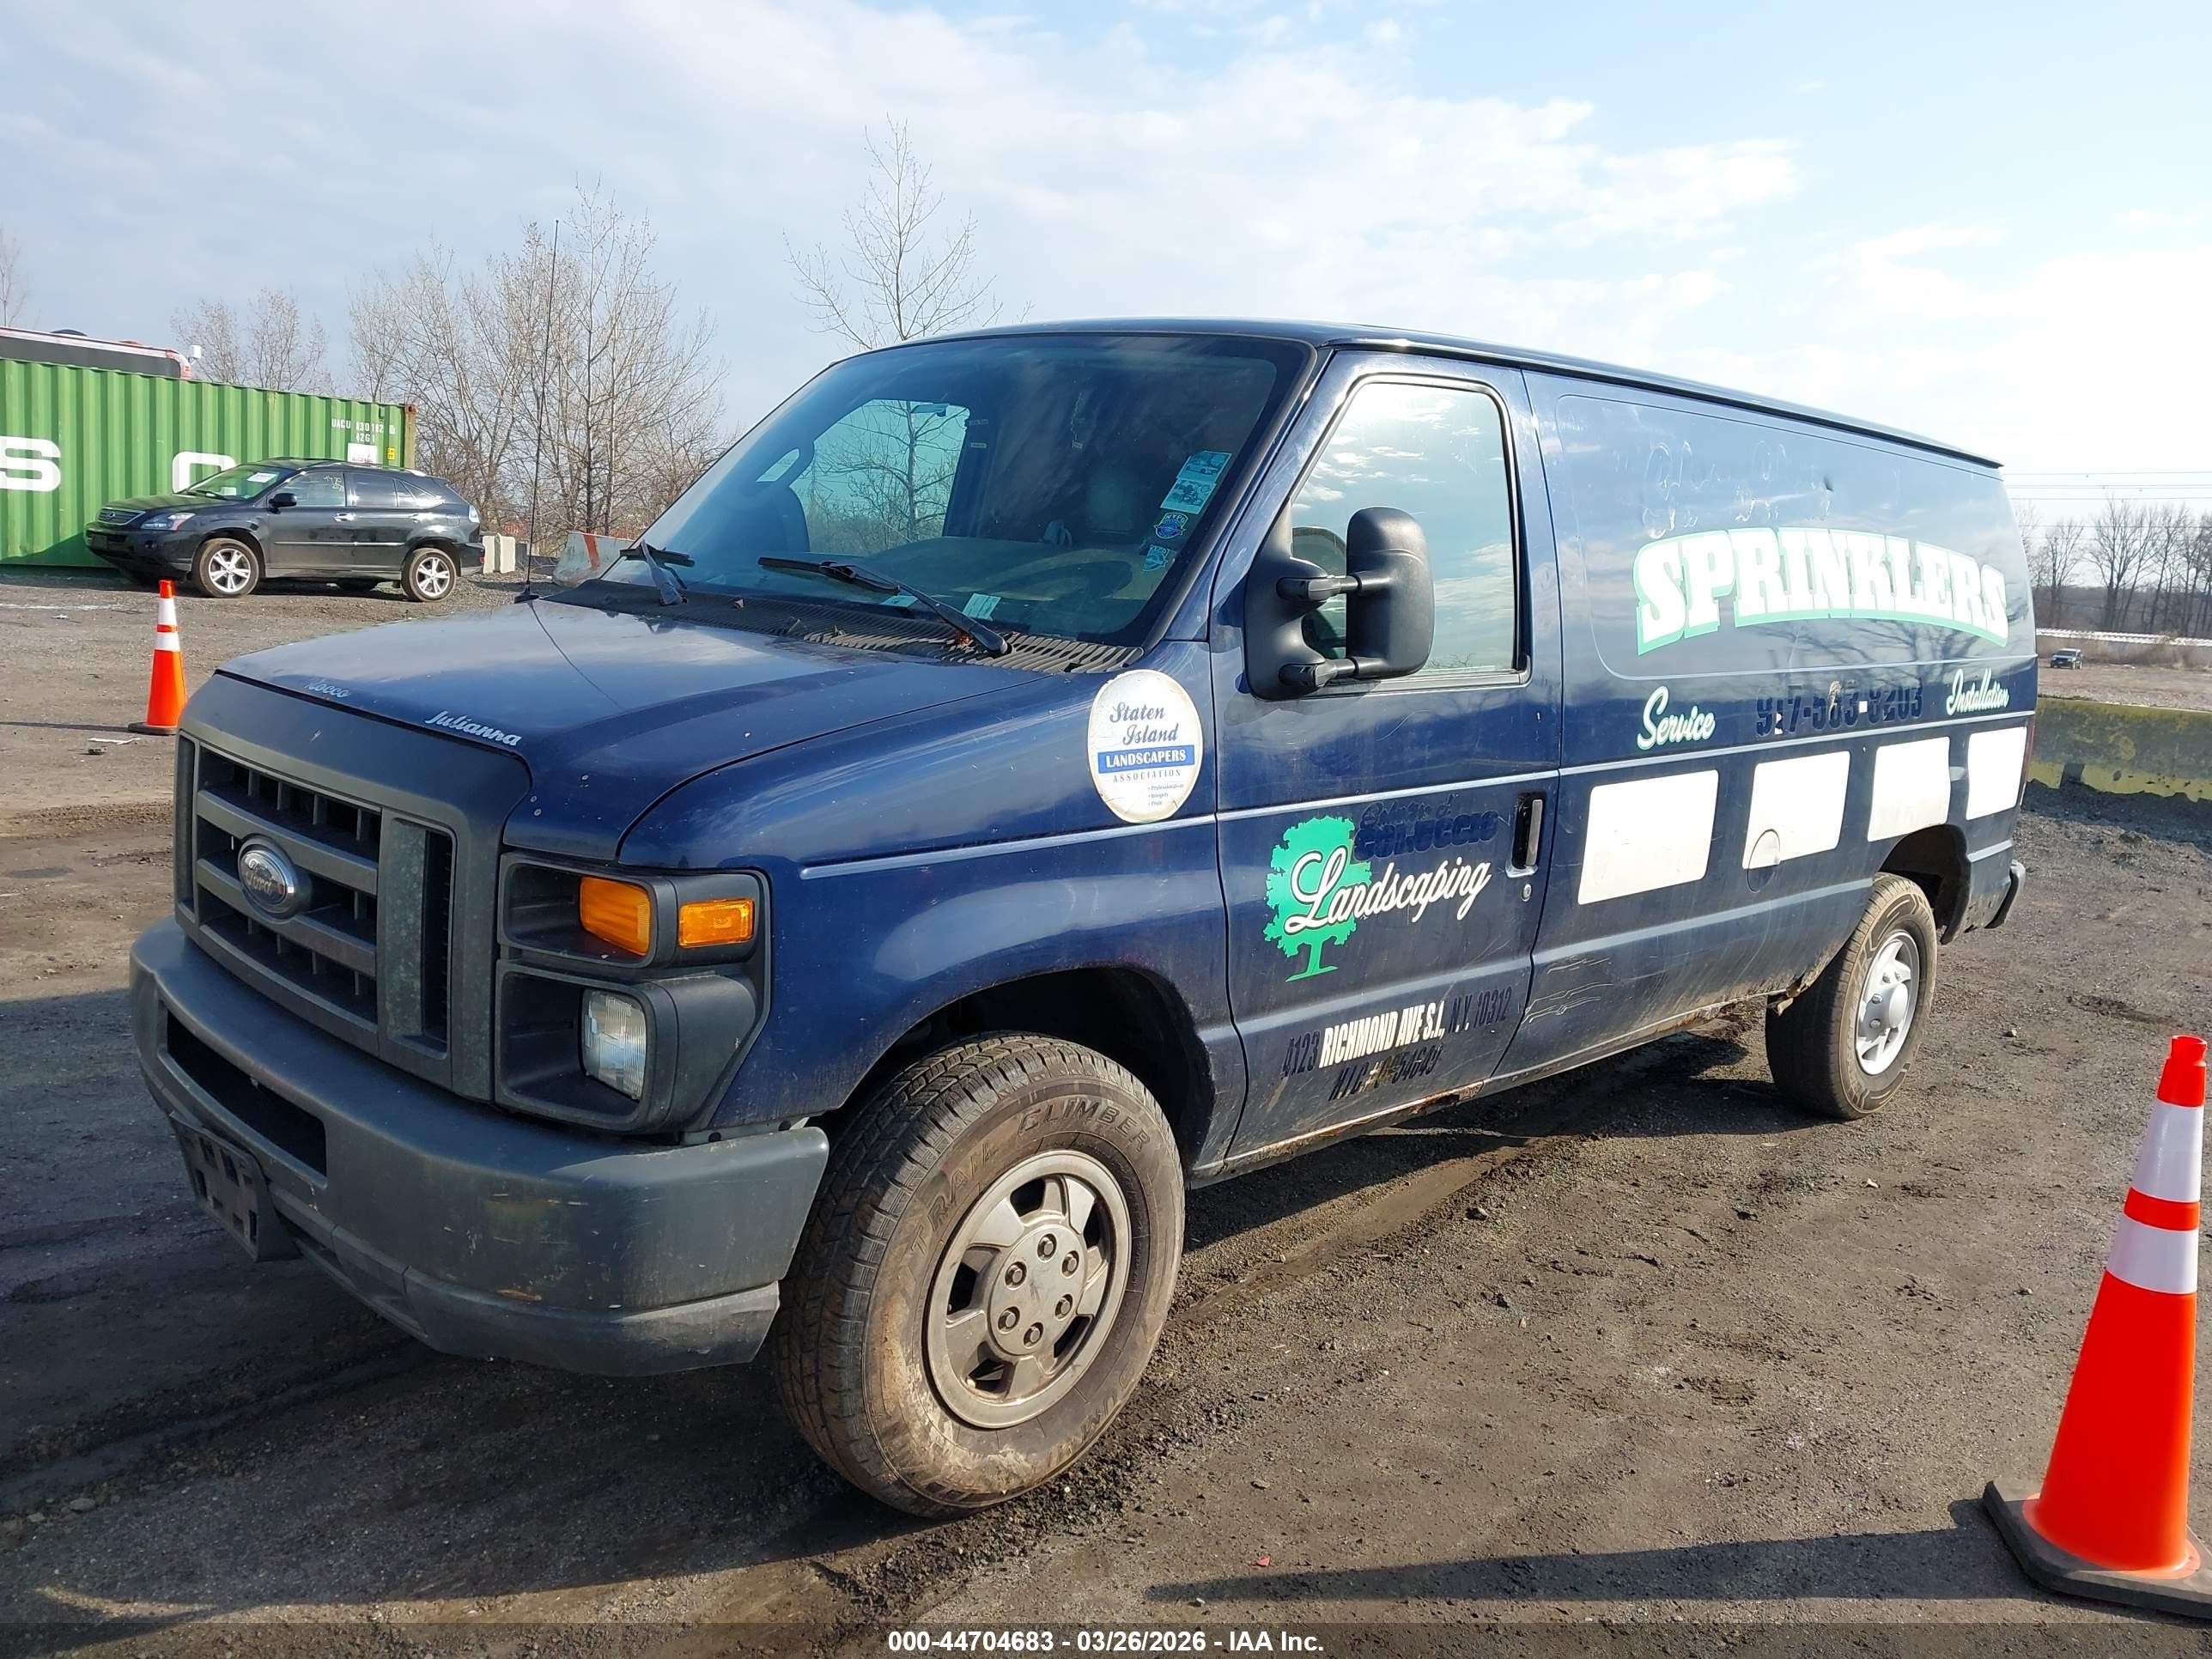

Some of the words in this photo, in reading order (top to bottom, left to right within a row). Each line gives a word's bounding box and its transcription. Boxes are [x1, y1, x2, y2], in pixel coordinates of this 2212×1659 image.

[331, 418, 351, 429] UACU
[0, 435, 61, 493] S
[1633, 526, 2009, 655] SPRINKLERS
[1109, 701, 1166, 724] Staten
[1946, 667, 2010, 716] Installation
[424, 709, 522, 747] Julianna
[1122, 722, 1179, 746] Island
[1637, 685, 1716, 750] Service
[1105, 749, 1187, 769] LANDSCAPERS
[1113, 769, 1182, 783] ASSOCIATION
[1284, 856, 1492, 935] Landscaping
[1281, 1030, 1321, 1079] 4123
[1318, 1011, 1399, 1069] RICHMOND
[1394, 1004, 1425, 1048] AVE
[1473, 985, 1512, 1029] 10312
[910, 1140, 1001, 1256] TRAIL
[1017, 1096, 1153, 1153] CLIMBER
